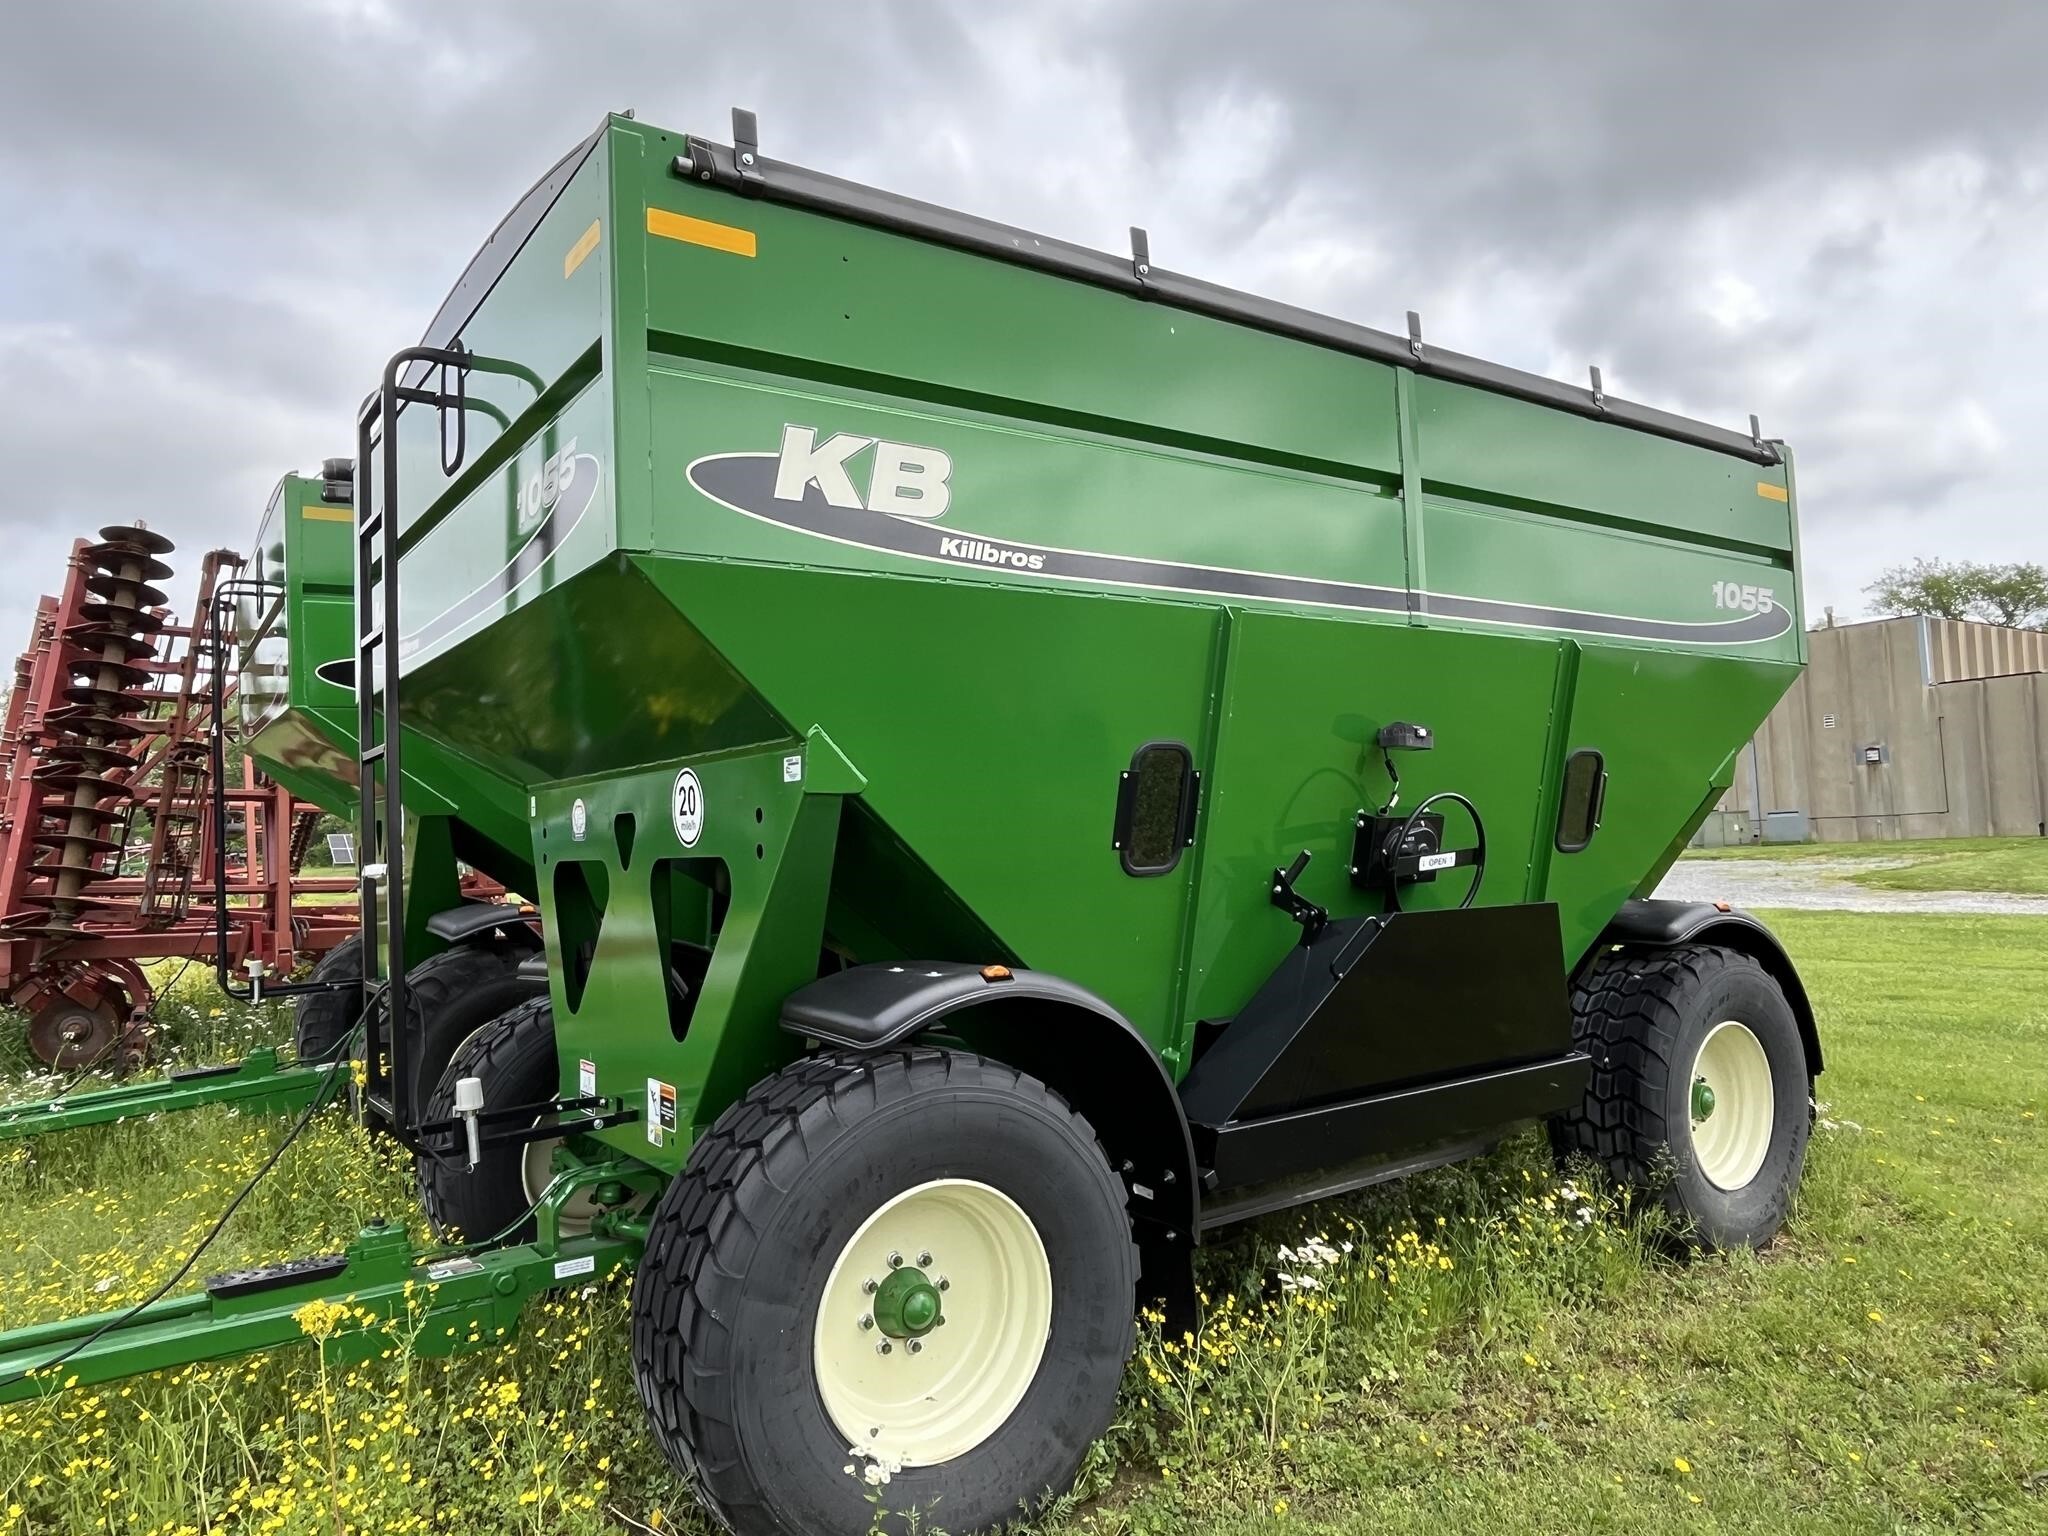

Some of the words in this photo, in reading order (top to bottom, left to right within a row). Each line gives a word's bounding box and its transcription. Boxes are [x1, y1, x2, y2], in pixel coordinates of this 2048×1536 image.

[517, 436, 577, 533] 1055
[774, 423, 952, 519] KB
[939, 537, 1046, 570] Killbros
[1711, 580, 1774, 614] 1055
[678, 785, 696, 817] 20
[1428, 857, 1447, 867] OPEN
